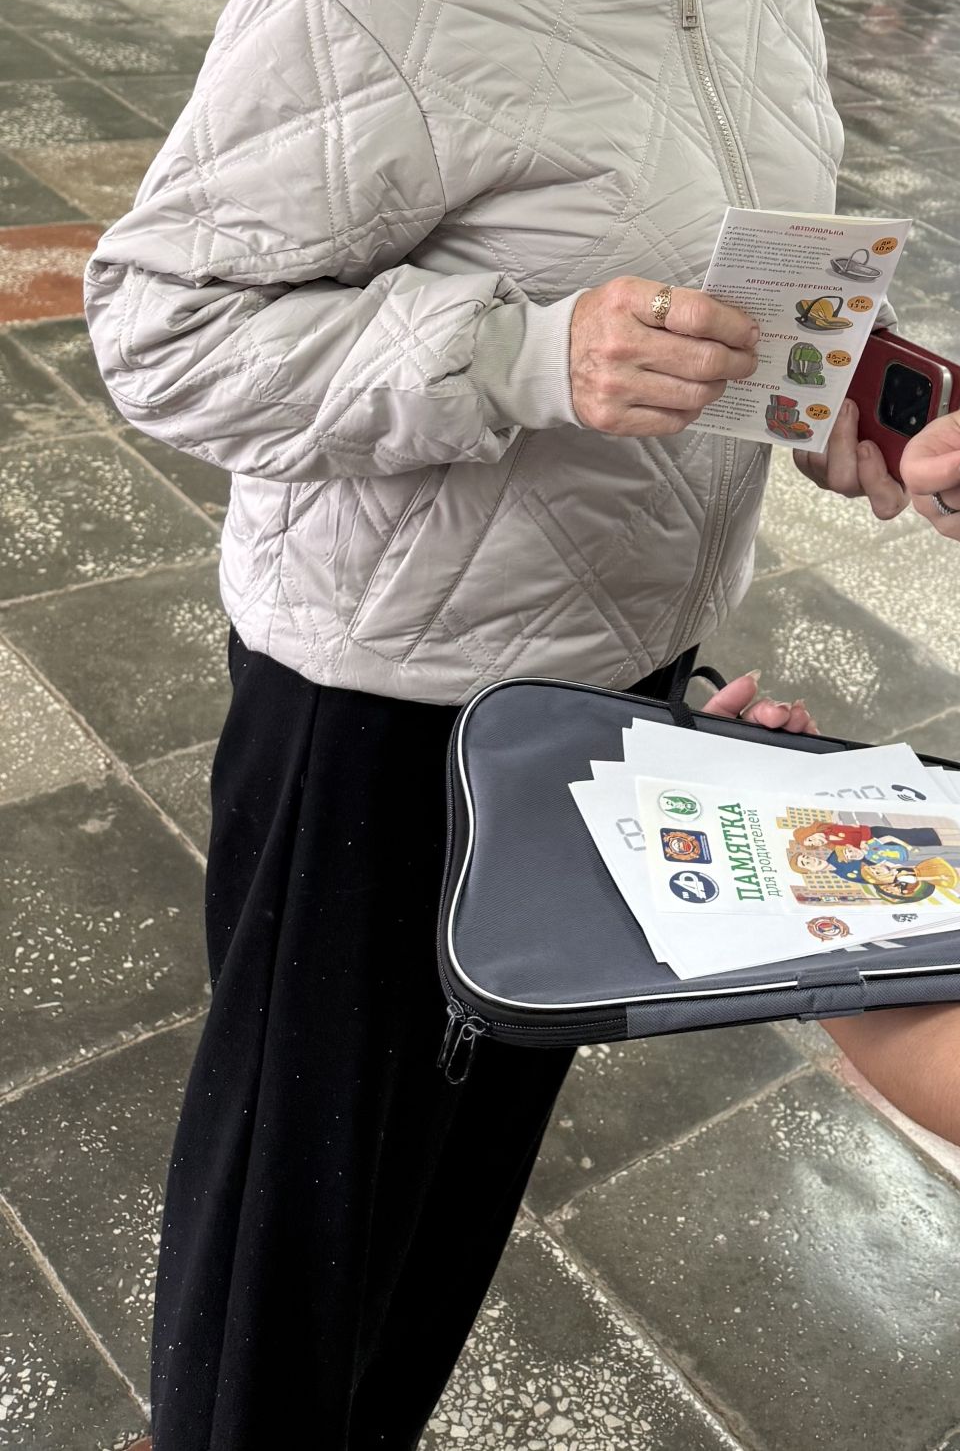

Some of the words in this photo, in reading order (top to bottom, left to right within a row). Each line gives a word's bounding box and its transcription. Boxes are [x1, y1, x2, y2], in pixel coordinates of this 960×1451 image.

[717, 802, 765, 902] ПАМЯТКА
[743, 809, 778, 874] родителей
[763, 876, 784, 898] для
